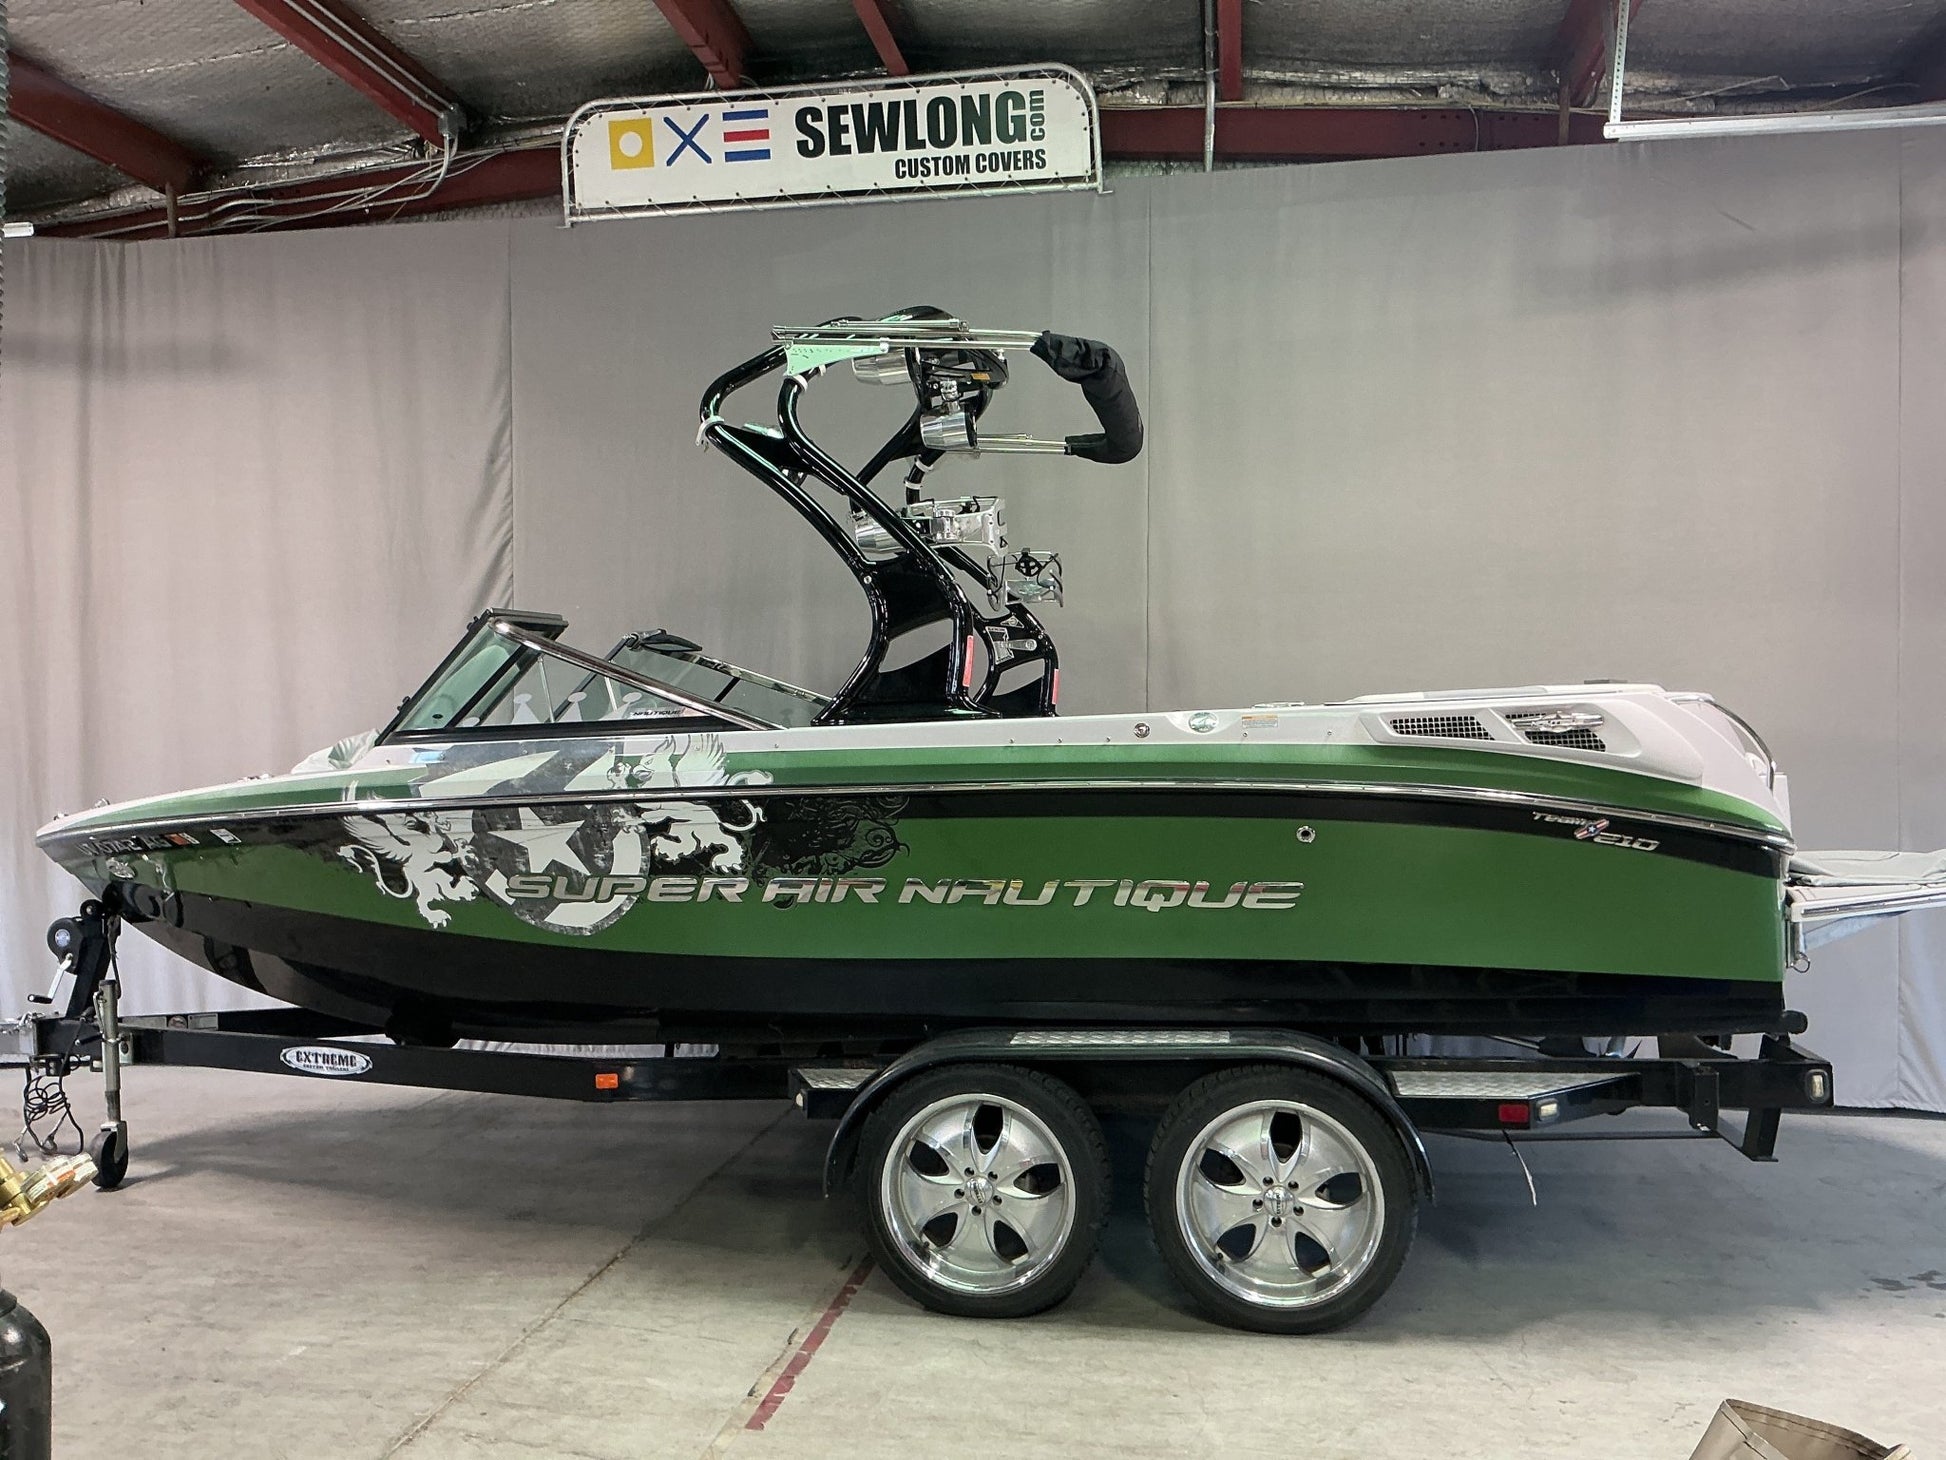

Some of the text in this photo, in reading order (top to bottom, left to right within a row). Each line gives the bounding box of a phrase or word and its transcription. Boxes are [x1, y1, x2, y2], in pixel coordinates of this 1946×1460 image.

[795, 90, 1027, 158] SEWLONG
[894, 148, 1047, 179] CUSTOM COVERS
[1593, 832, 1660, 851] 210
[506, 874, 1304, 912] SUPER AIR NAUTIQUE
[295, 1050, 357, 1068] EXTREME
